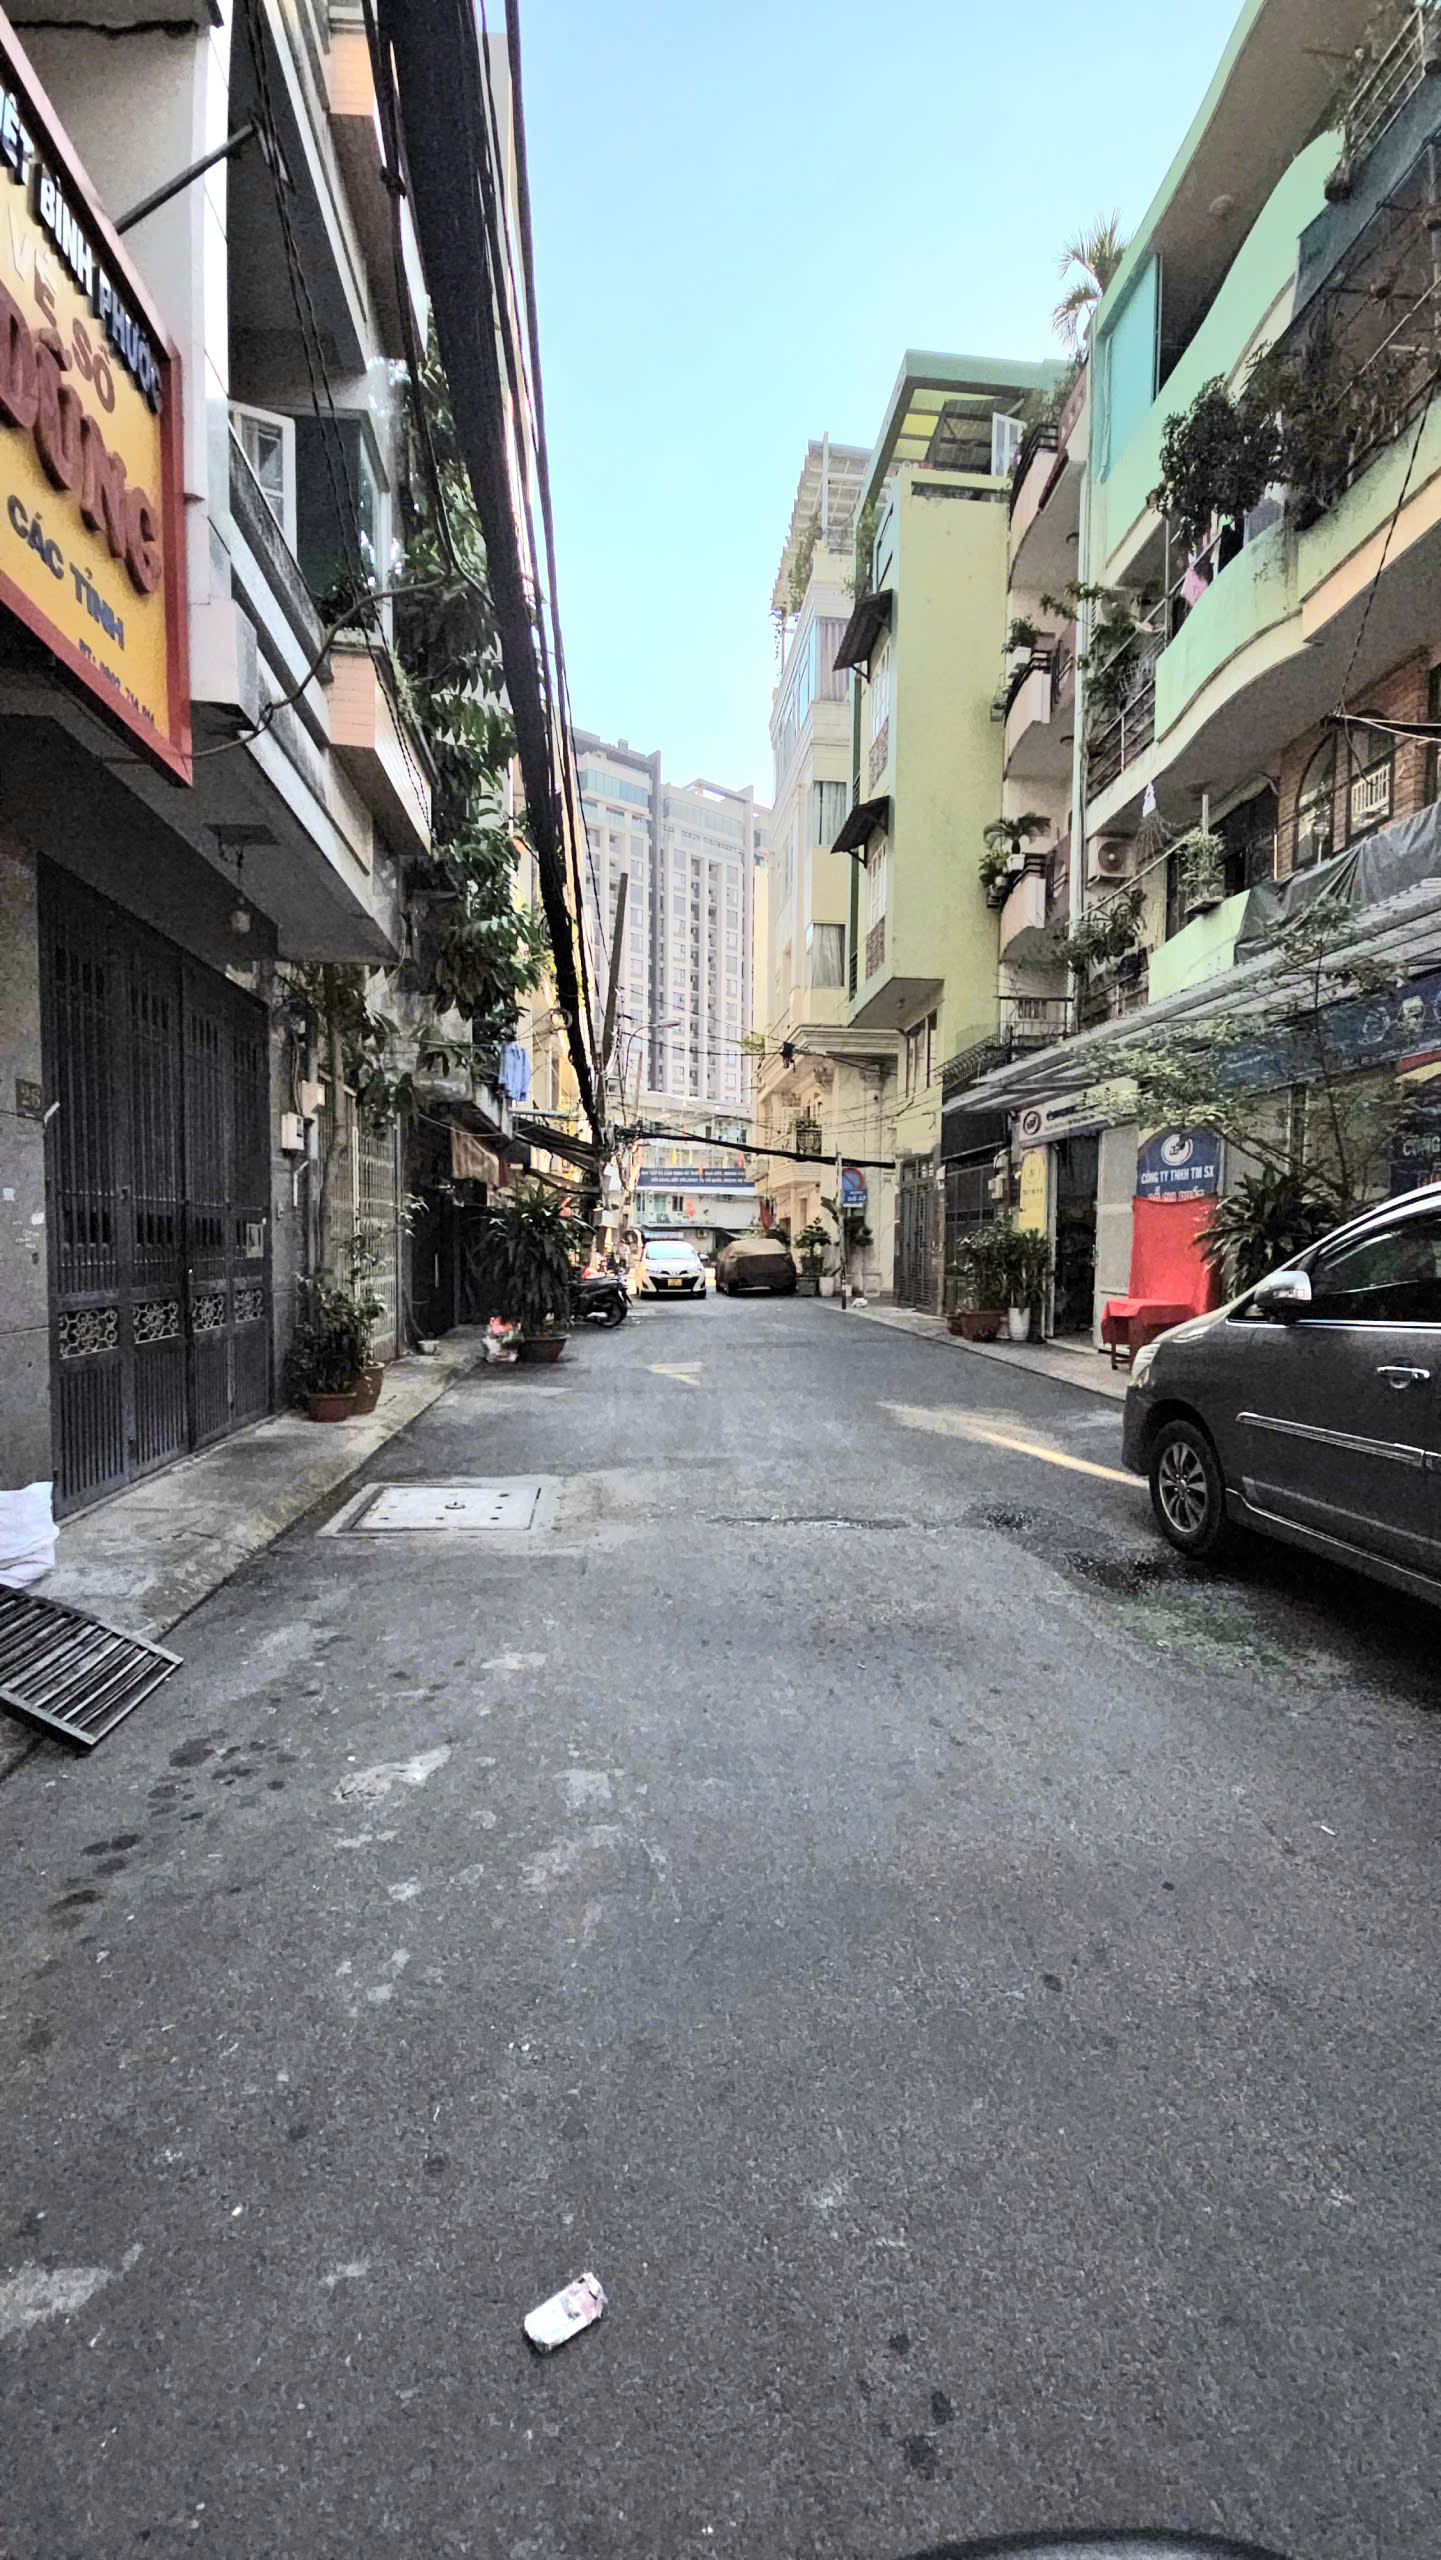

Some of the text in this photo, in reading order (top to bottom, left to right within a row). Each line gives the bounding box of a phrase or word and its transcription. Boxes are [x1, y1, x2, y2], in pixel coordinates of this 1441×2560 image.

[40, 173, 93, 296] BÌNH
[72, 317, 116, 413] SỐ
[8, 494, 125, 651] CÁC TỈNH
[1160, 1169, 1169, 1182] TY
[1170, 1167, 1189, 1182] TNHH
[1204, 1165, 1215, 1178] SX
